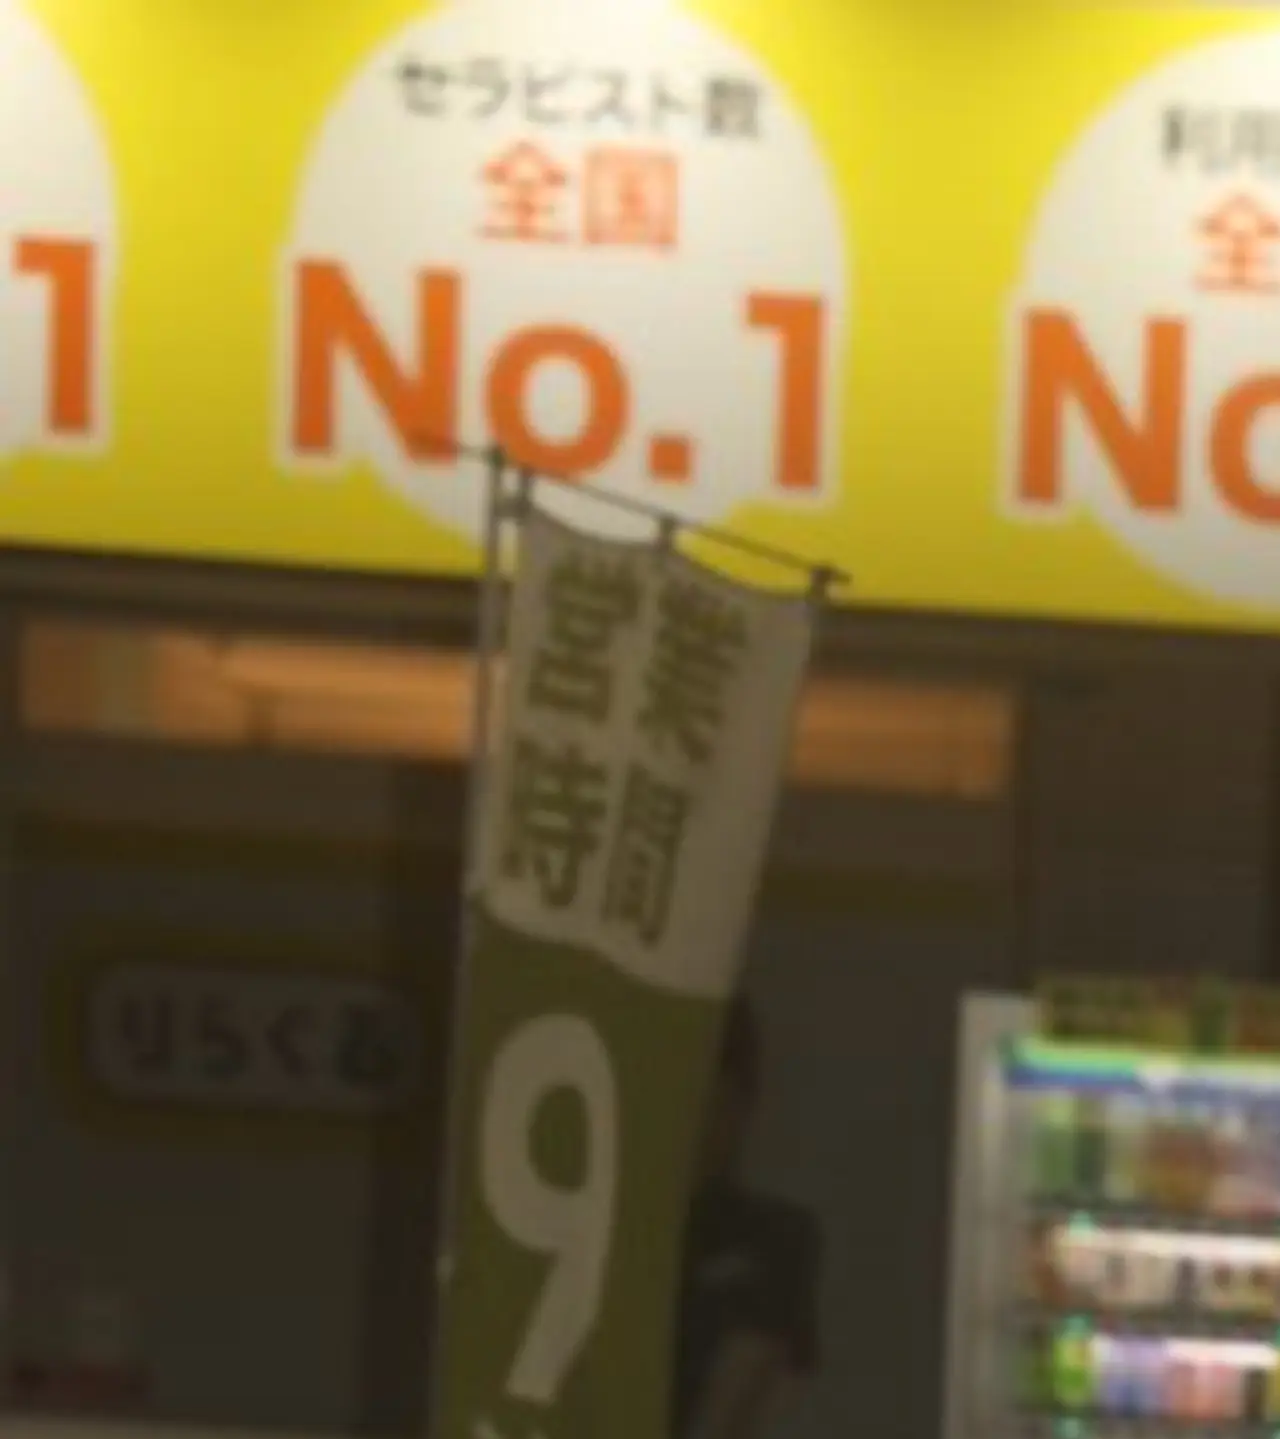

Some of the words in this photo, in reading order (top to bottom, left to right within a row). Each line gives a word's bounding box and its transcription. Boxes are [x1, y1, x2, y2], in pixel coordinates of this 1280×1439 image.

[398, 56, 764, 142] セラピスト数
[475, 140, 682, 256] 全国
[293, 258, 825, 490] No.1
